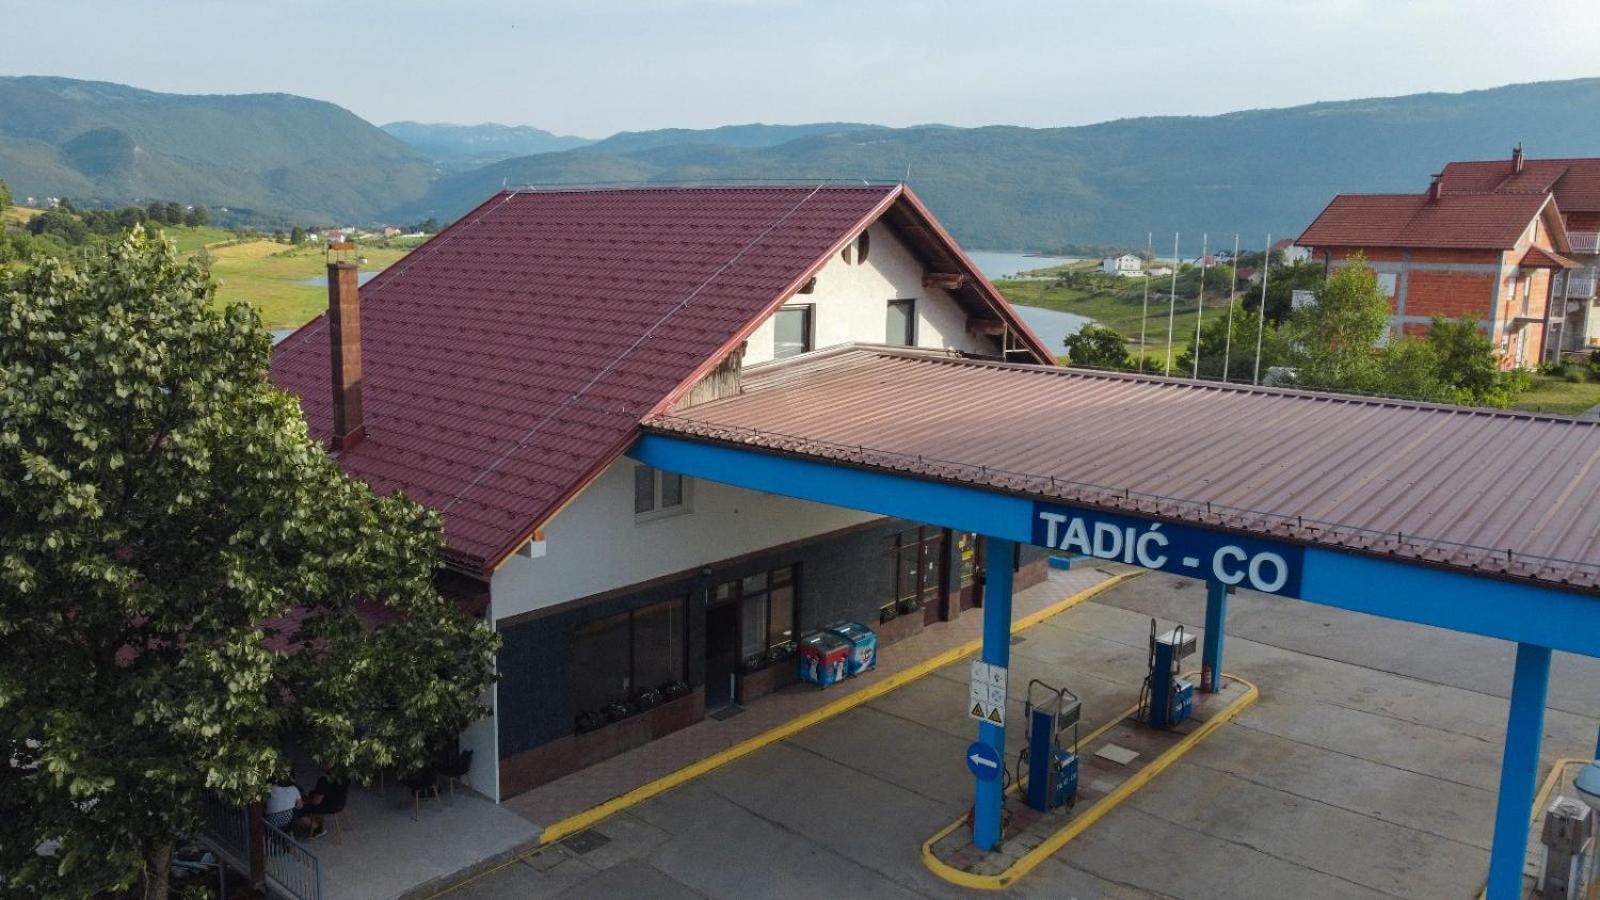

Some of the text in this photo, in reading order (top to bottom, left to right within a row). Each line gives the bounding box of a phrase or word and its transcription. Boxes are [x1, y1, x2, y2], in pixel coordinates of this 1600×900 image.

[1039, 511, 1289, 593] TADIĆ - CO
